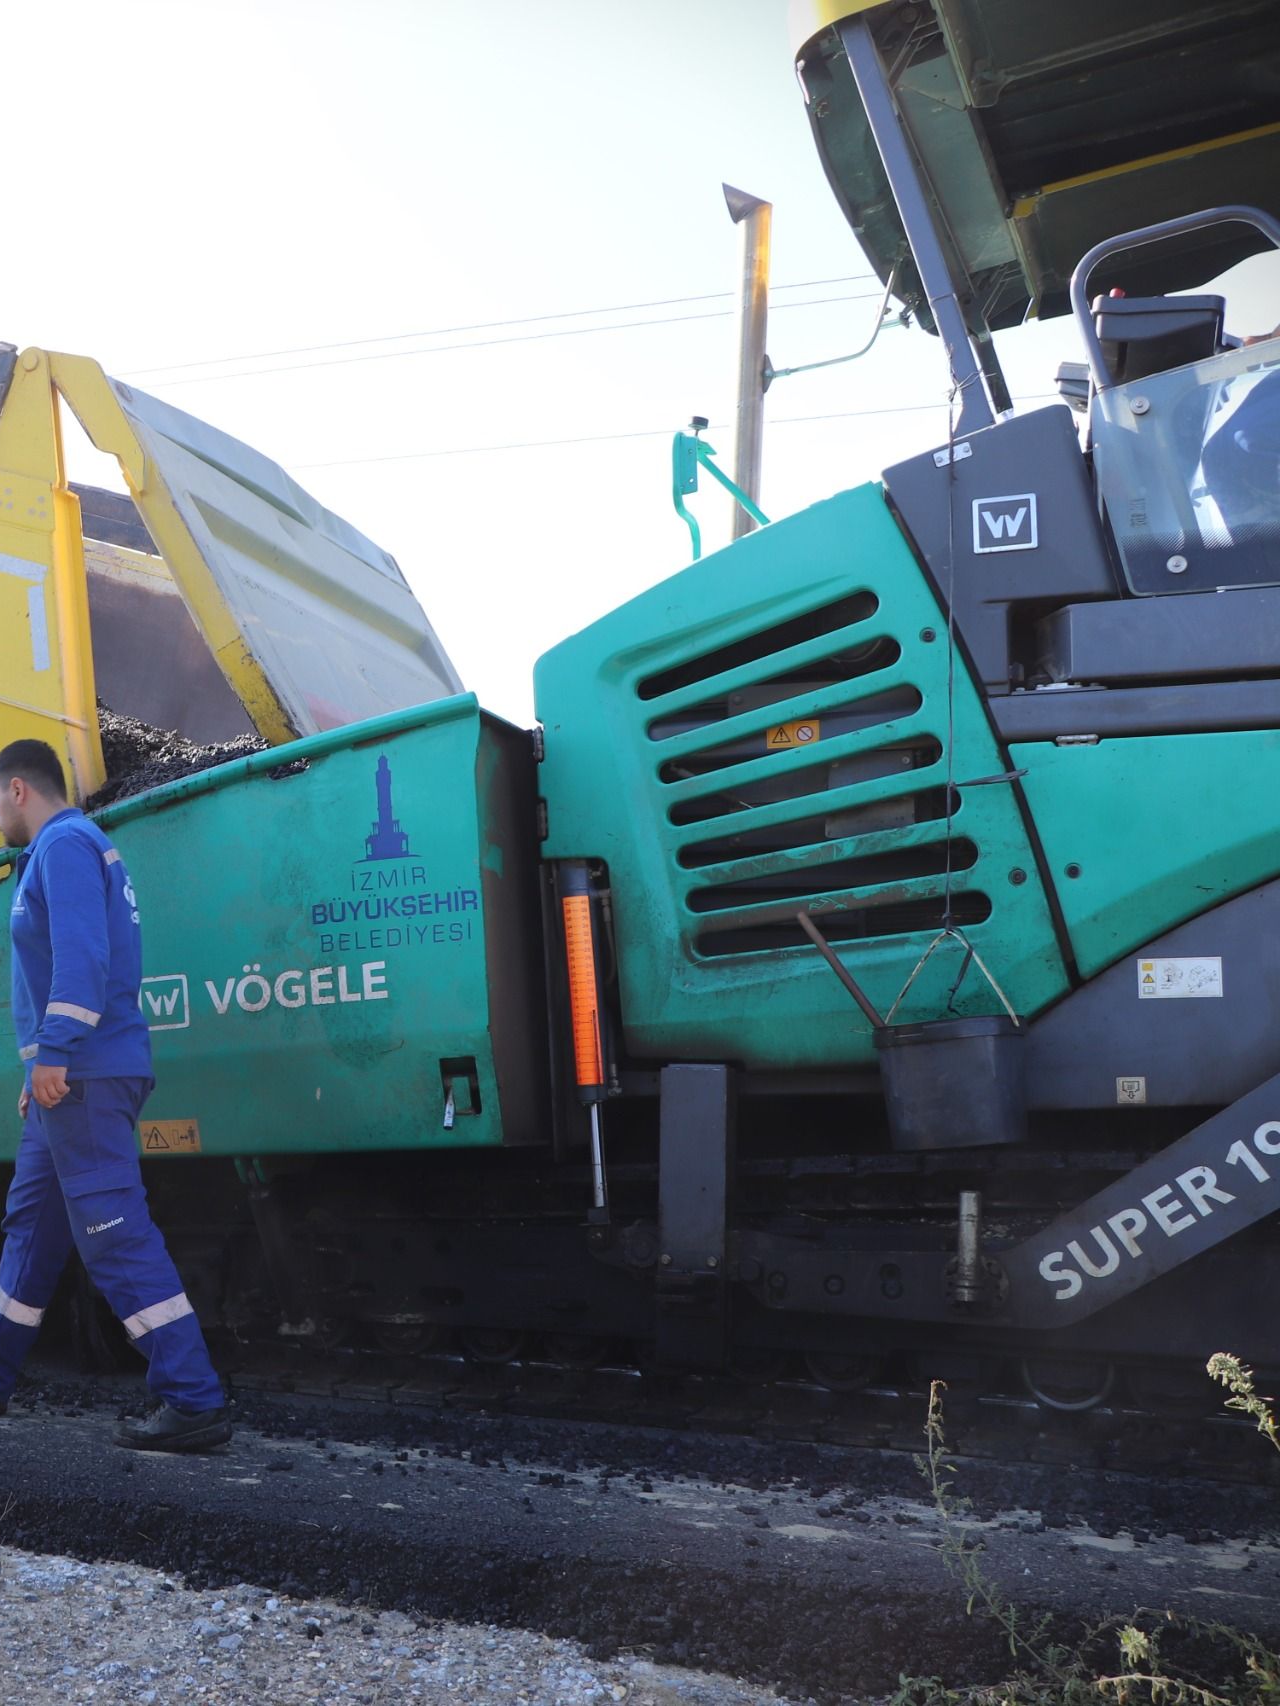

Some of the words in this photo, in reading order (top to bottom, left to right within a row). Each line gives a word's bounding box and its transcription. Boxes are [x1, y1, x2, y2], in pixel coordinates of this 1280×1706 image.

[351, 865, 427, 892] İZMİR
[311, 886, 479, 925] BÜYÜKŞEHİR
[320, 918, 472, 953] BELEDİYESİ
[205, 960, 389, 1015] VÖGELE
[95, 1216, 125, 1232] izbeton
[1038, 1165, 1237, 1300] SUPER
